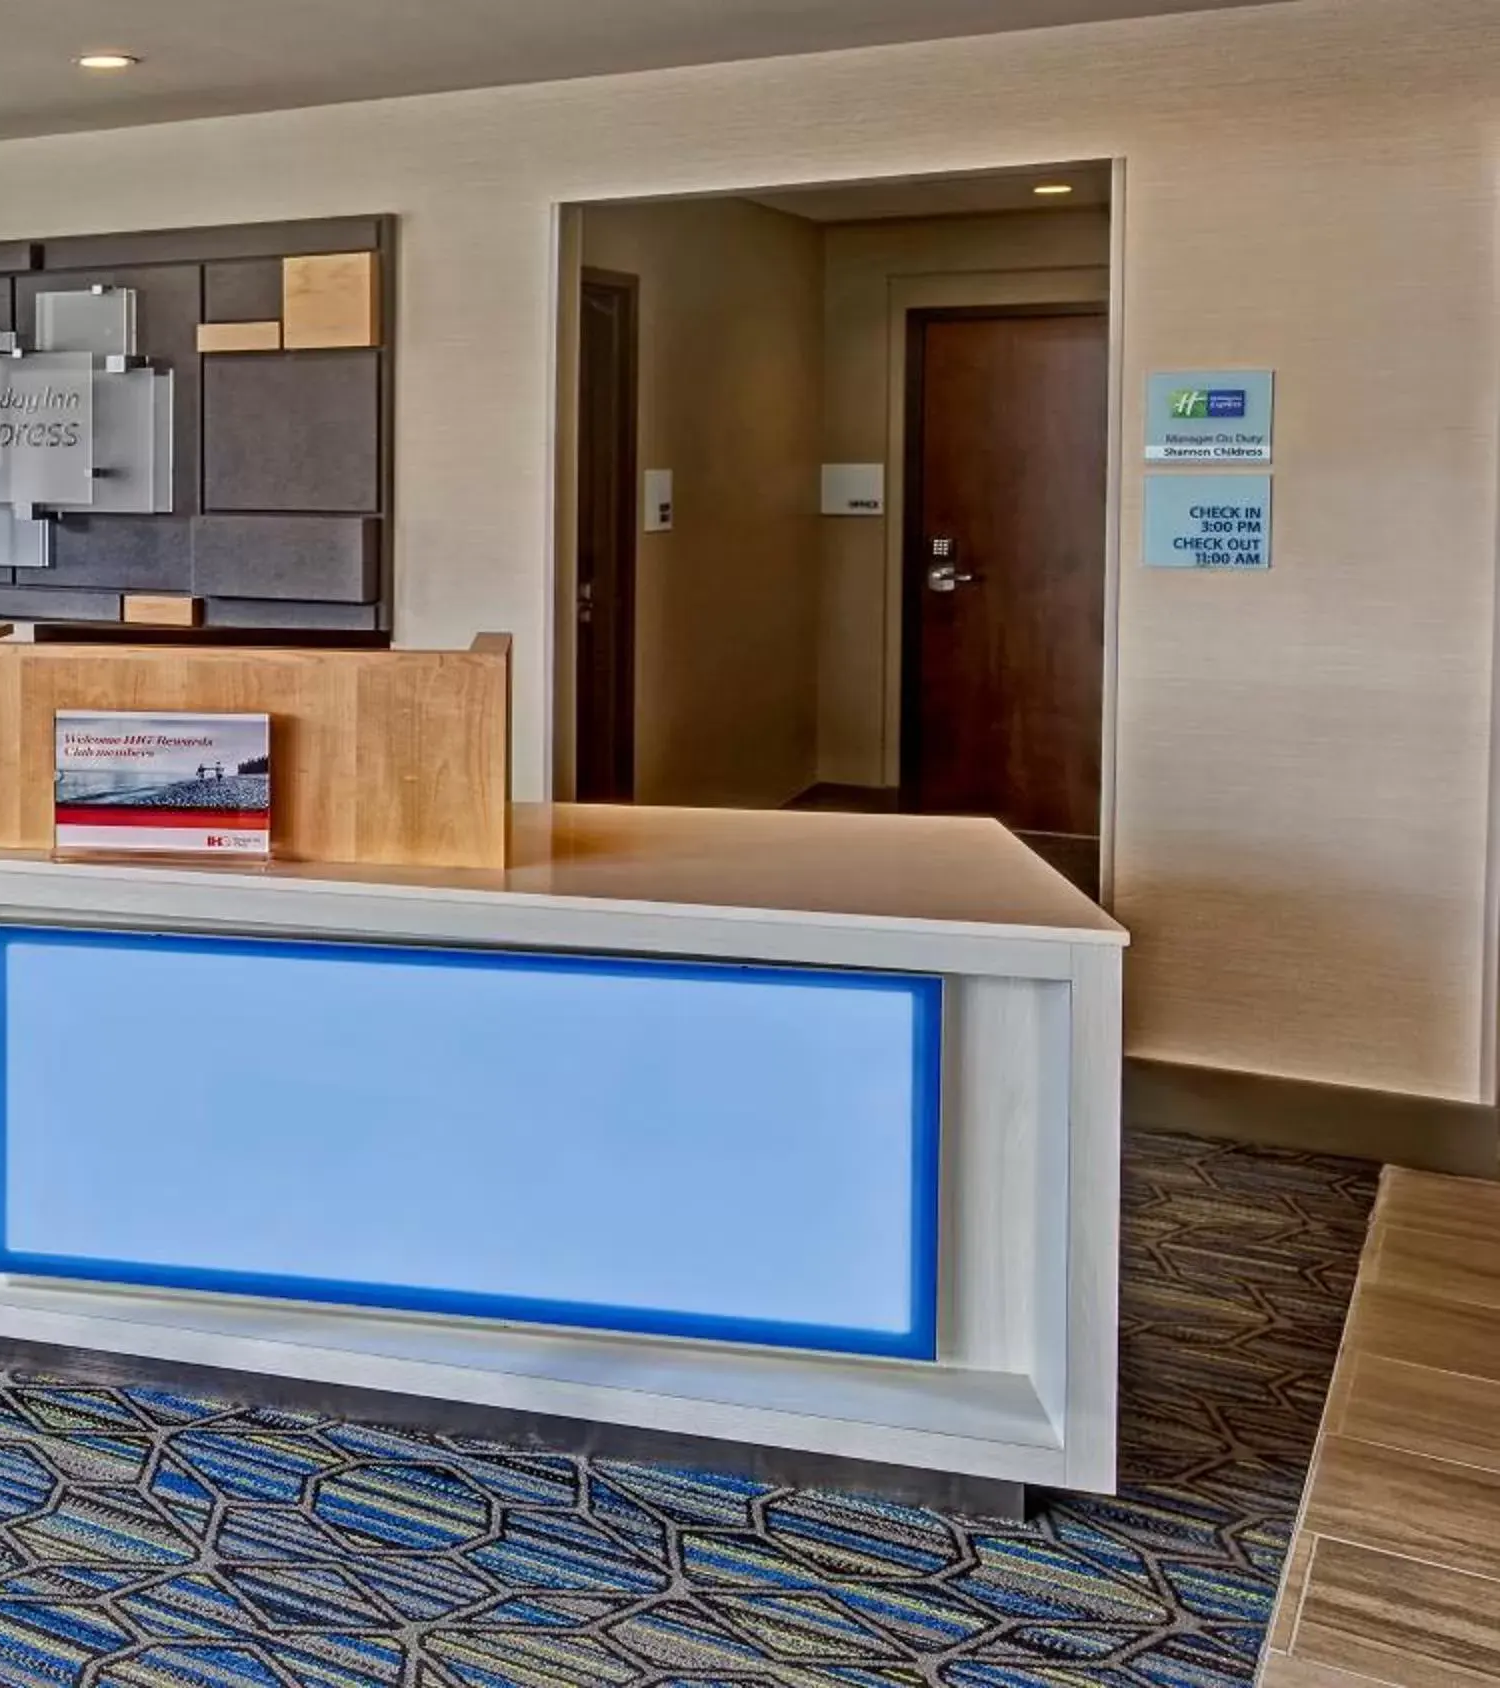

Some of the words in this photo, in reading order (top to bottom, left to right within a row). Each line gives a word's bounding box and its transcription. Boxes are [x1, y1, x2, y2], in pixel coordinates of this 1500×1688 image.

[43, 386, 80, 409] Inn
[1215, 433, 1233, 443] On
[1235, 433, 1263, 445] Duty
[1163, 447, 1211, 457] Shannon
[1213, 447, 1263, 457] Childress
[1189, 506, 1241, 519] CHECK
[1245, 506, 1261, 519] IN
[1201, 521, 1233, 533] 3:00
[1237, 521, 1261, 533] PM
[1173, 537, 1223, 550] CHECK
[1227, 537, 1261, 551] OUT
[1195, 552, 1230, 565] 11:00
[1234, 553, 1261, 565] AM
[64, 733, 121, 745] Welcome
[123, 735, 155, 745] IHG
[157, 735, 213, 747] Rewards
[64, 747, 94, 757] Club
[95, 747, 155, 758] members
